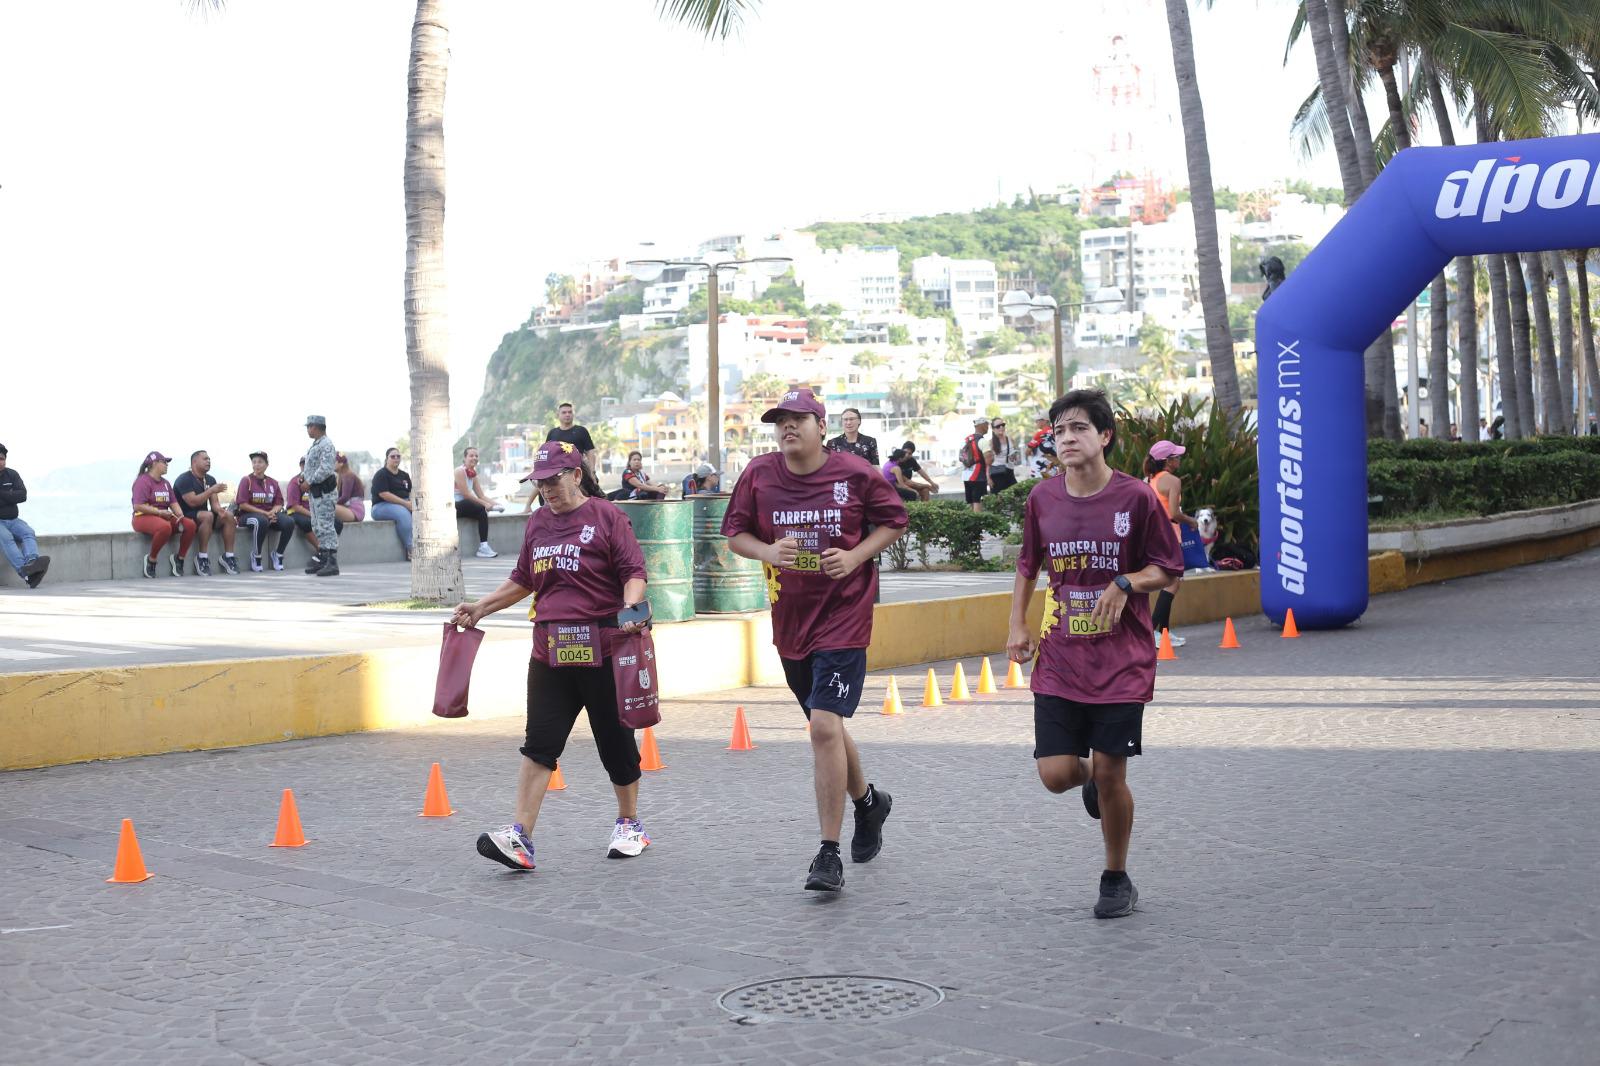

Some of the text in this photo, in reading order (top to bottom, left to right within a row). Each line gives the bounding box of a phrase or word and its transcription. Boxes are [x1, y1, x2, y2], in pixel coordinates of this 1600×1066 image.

[1277, 340, 1308, 596] dportenis.mx
[772, 509, 841, 525] CARRERA IPN
[813, 524, 842, 537] 26
[532, 543, 581, 560] CARRERA IPN
[1049, 540, 1120, 557] CARRERA IPN
[555, 556, 579, 572] 2026
[794, 556, 818, 569] 436
[1052, 555, 1119, 573] ONCE K 2026
[1069, 590, 1095, 600] CARRERA
[558, 626, 580, 634] CARRERA
[560, 650, 591, 661] 0045
